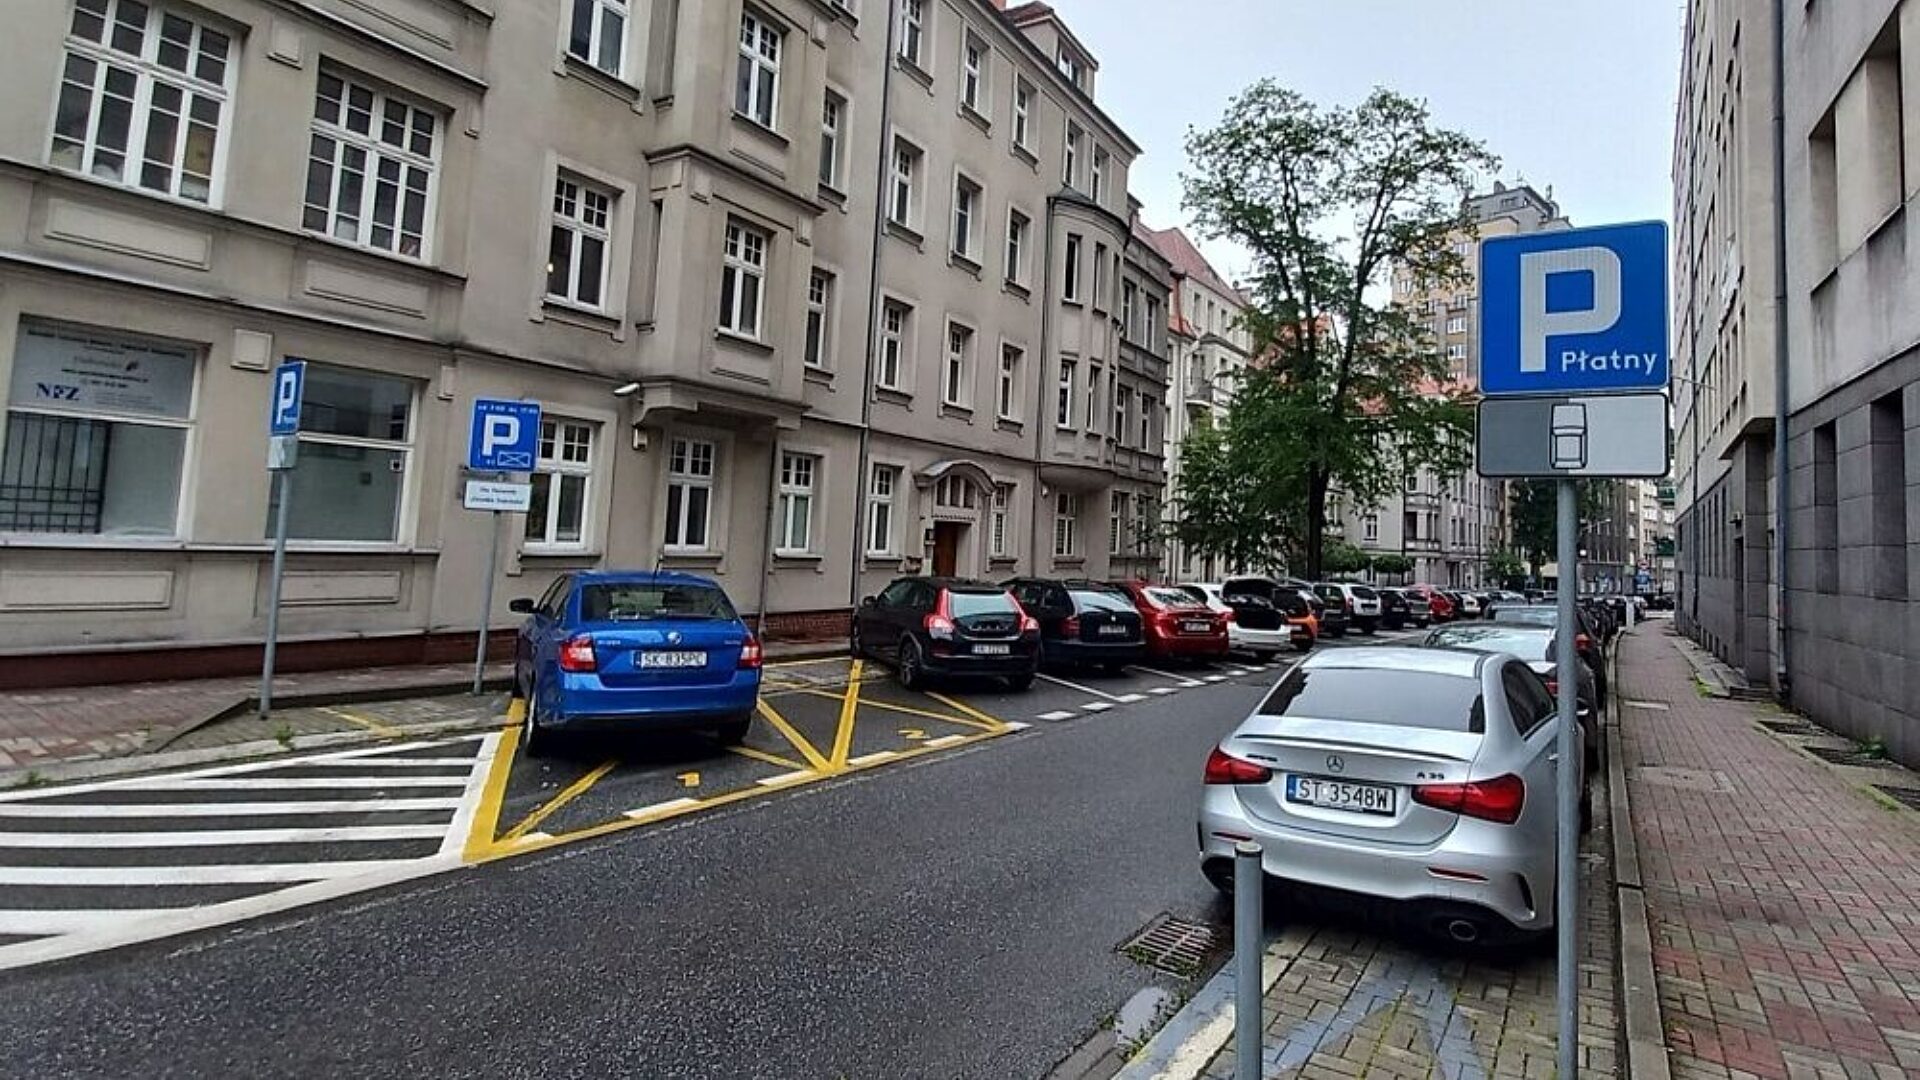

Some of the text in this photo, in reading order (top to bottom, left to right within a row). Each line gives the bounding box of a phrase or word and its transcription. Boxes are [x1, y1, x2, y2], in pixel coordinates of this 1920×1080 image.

[1520, 246, 1621, 372] P
[1562, 350, 1657, 375] Płatny
[36, 382, 80, 401] NFZ
[276, 371, 297, 425] P
[482, 413, 520, 456] P
[1299, 779, 1388, 810] ST 3548W
